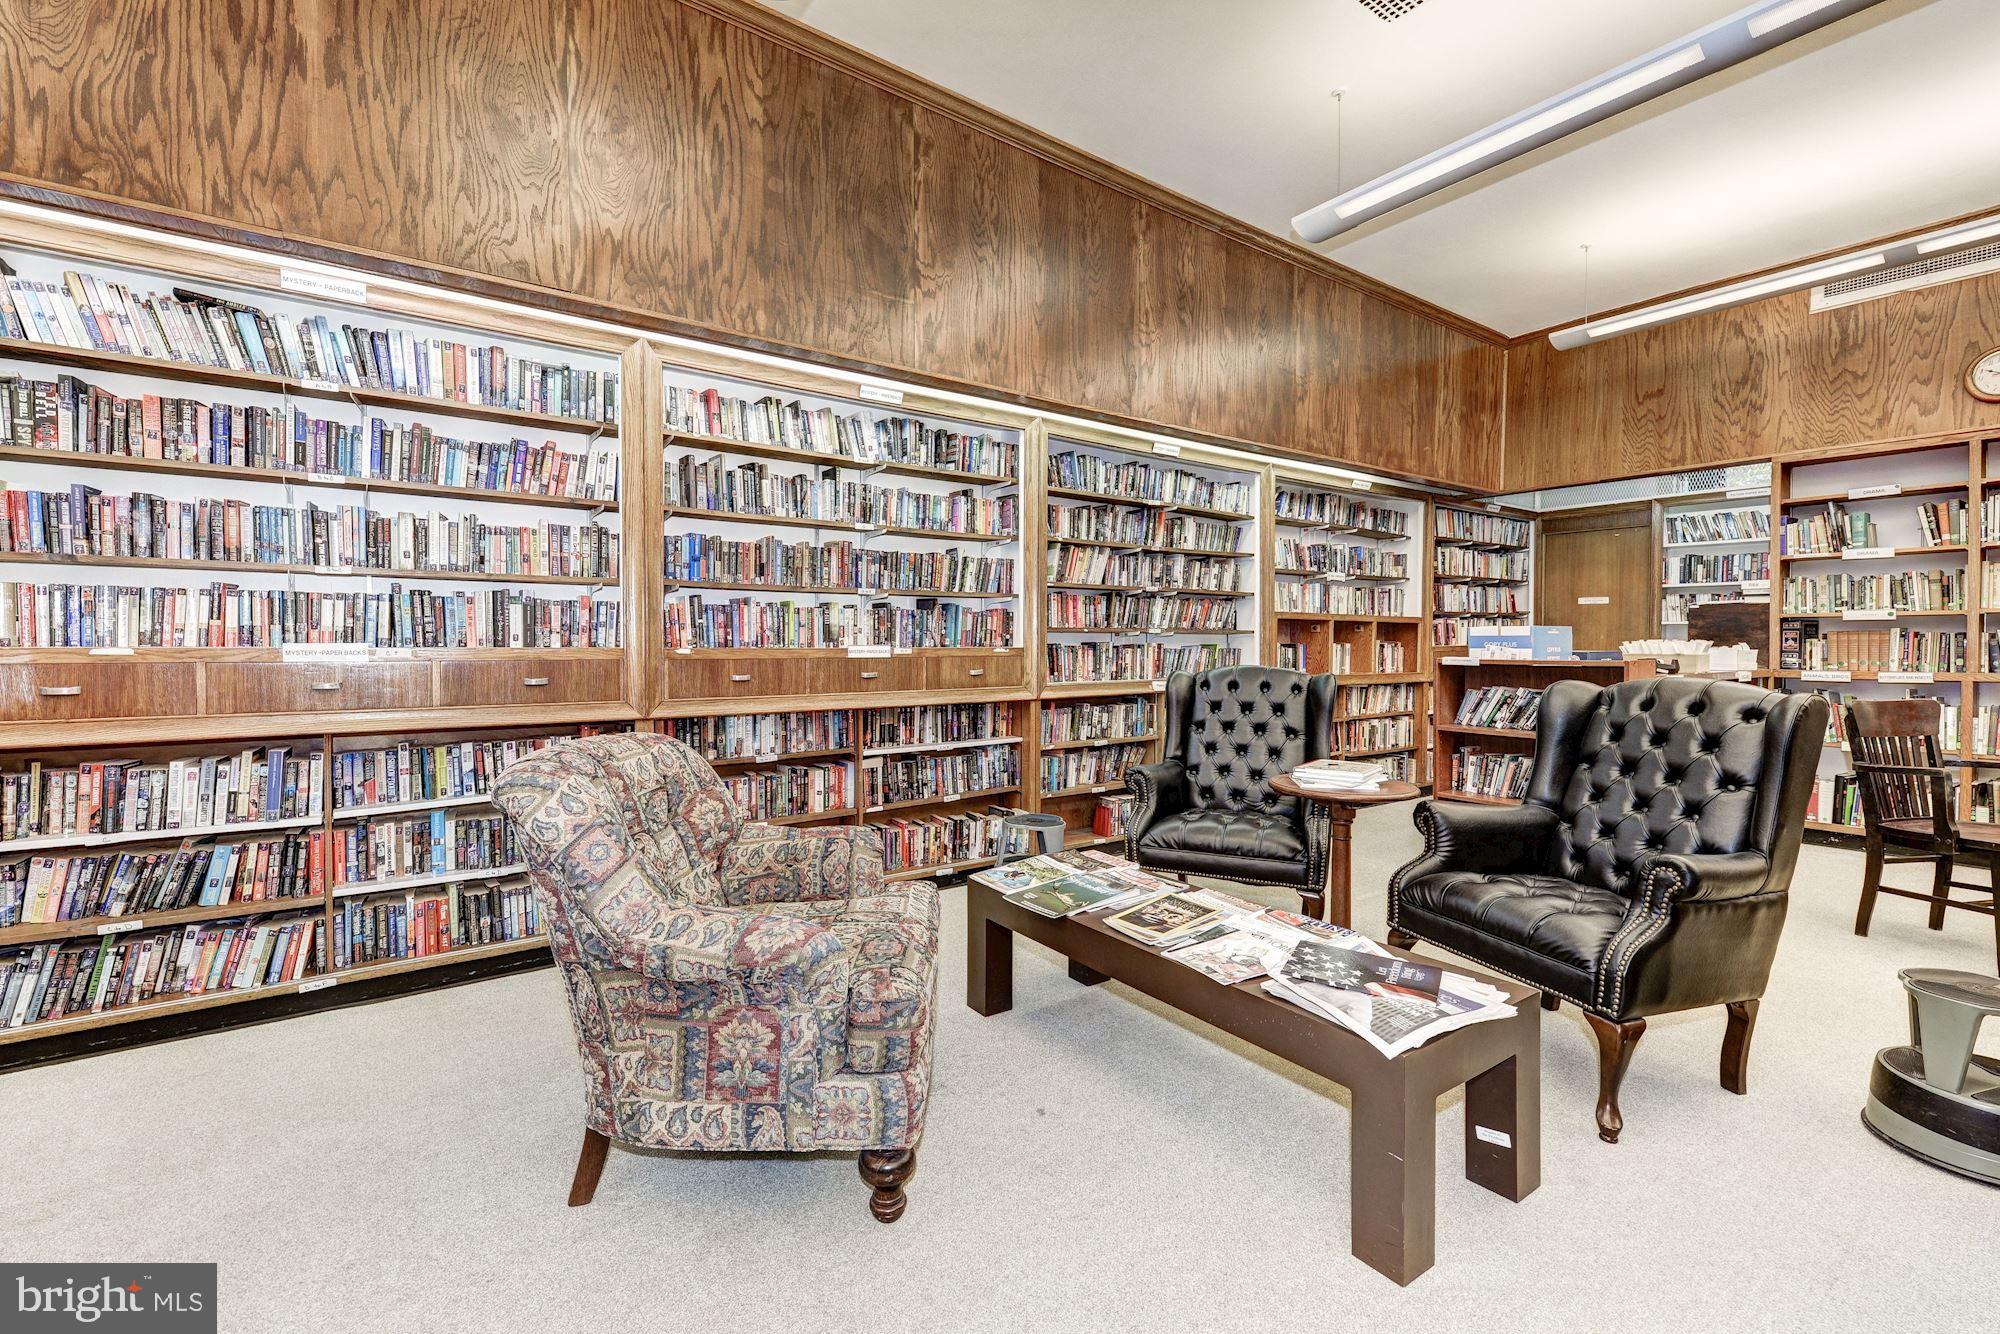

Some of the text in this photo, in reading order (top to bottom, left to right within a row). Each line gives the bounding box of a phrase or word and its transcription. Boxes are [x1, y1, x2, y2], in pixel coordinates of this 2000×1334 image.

[282, 276, 316, 288] MYSTERY
[324, 284, 364, 296] PAPERBACK
[36, 392, 46, 418] BELL
[45, 396, 56, 416] TED
[17, 390, 31, 446] TED BELL SPY
[1386, 961, 1403, 984] Freedom
